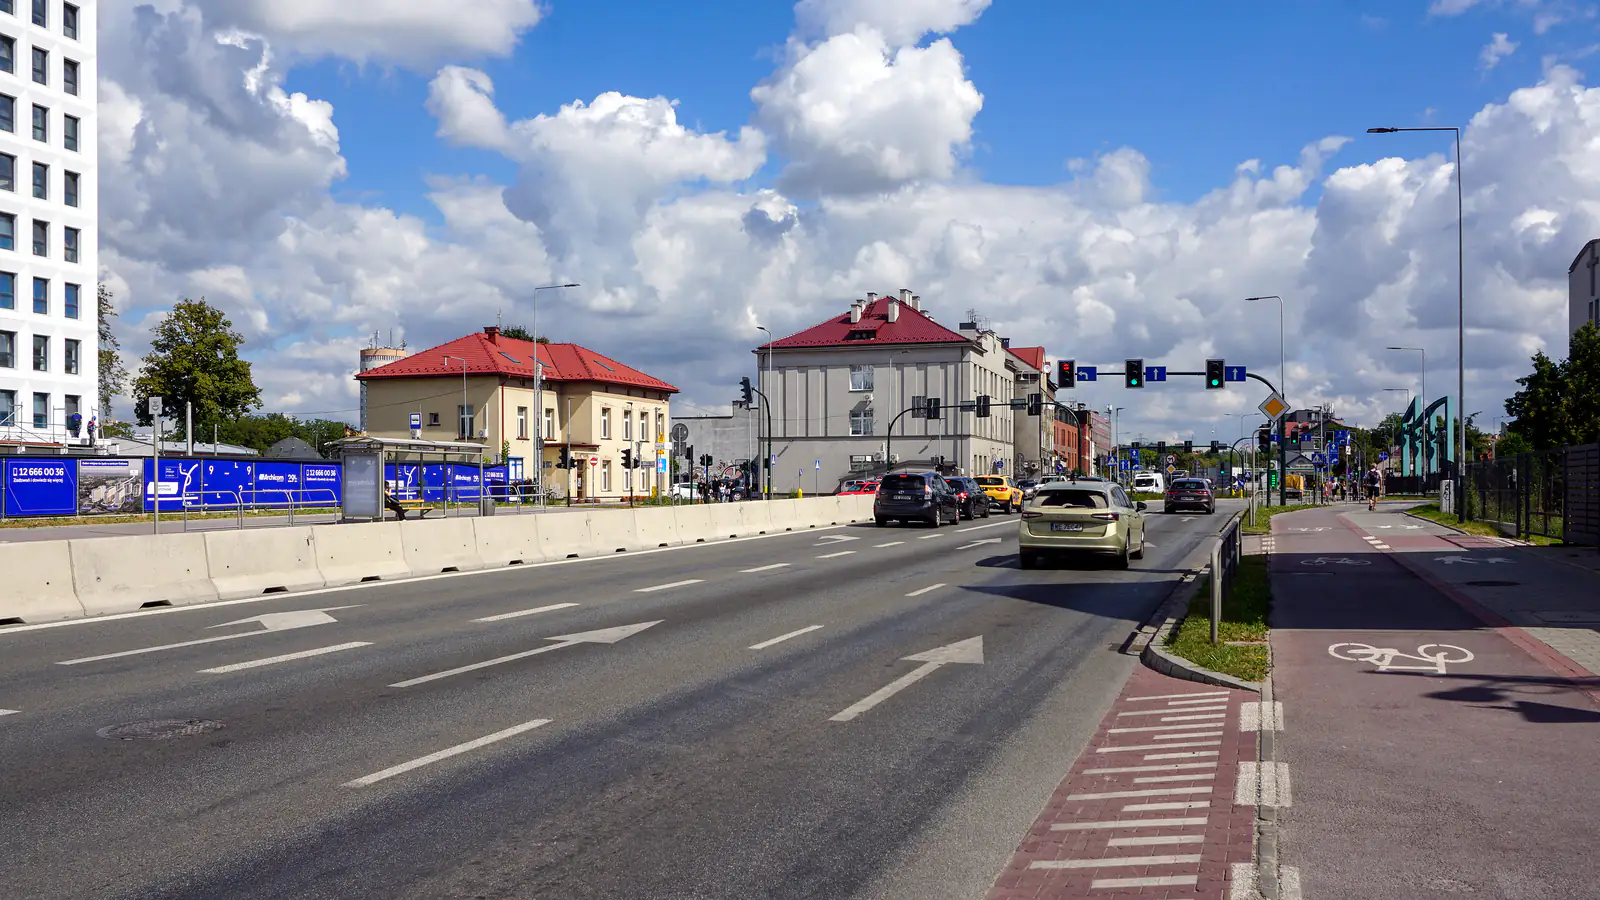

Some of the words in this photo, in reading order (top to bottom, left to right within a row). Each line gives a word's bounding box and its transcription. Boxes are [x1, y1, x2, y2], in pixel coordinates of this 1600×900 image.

[19, 467, 28, 476] 12
[28, 467, 43, 476] 666
[43, 467, 55, 476] 00
[55, 467, 64, 476] 36
